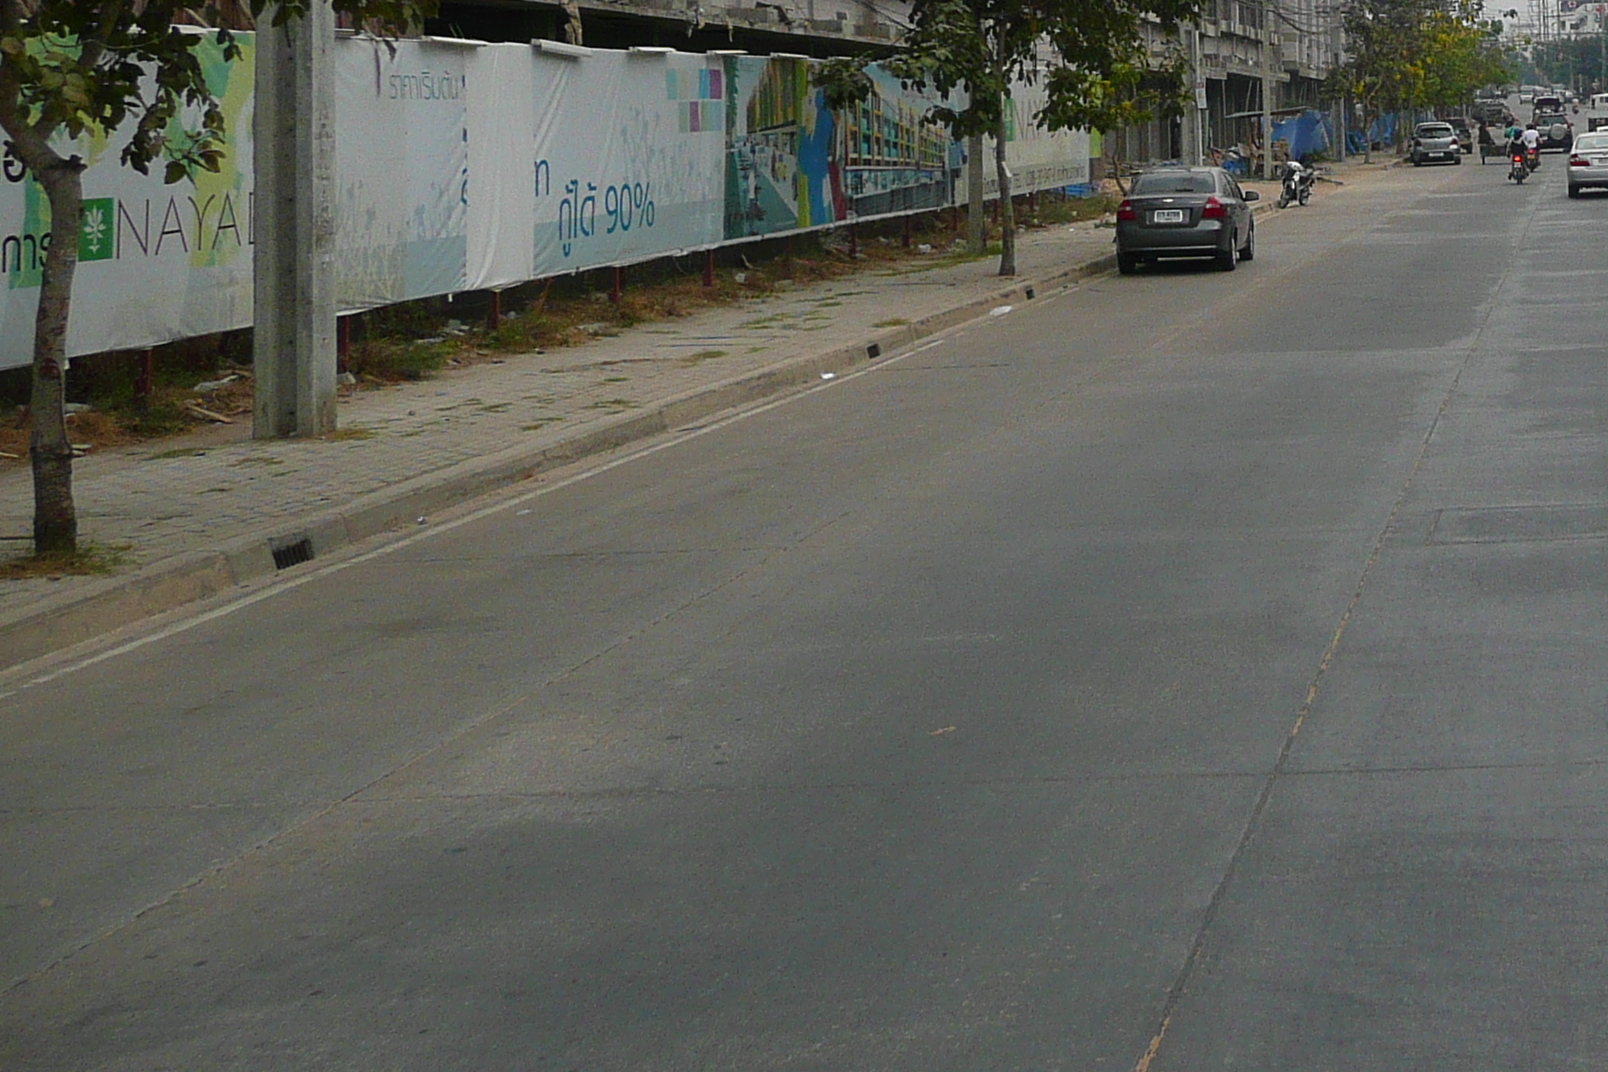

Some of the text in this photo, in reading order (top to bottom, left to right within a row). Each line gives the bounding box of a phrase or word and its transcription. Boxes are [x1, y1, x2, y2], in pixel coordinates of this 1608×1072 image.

[116, 191, 255, 260] NAYA
[558, 180, 655, 257] กู้ได้ 90%
